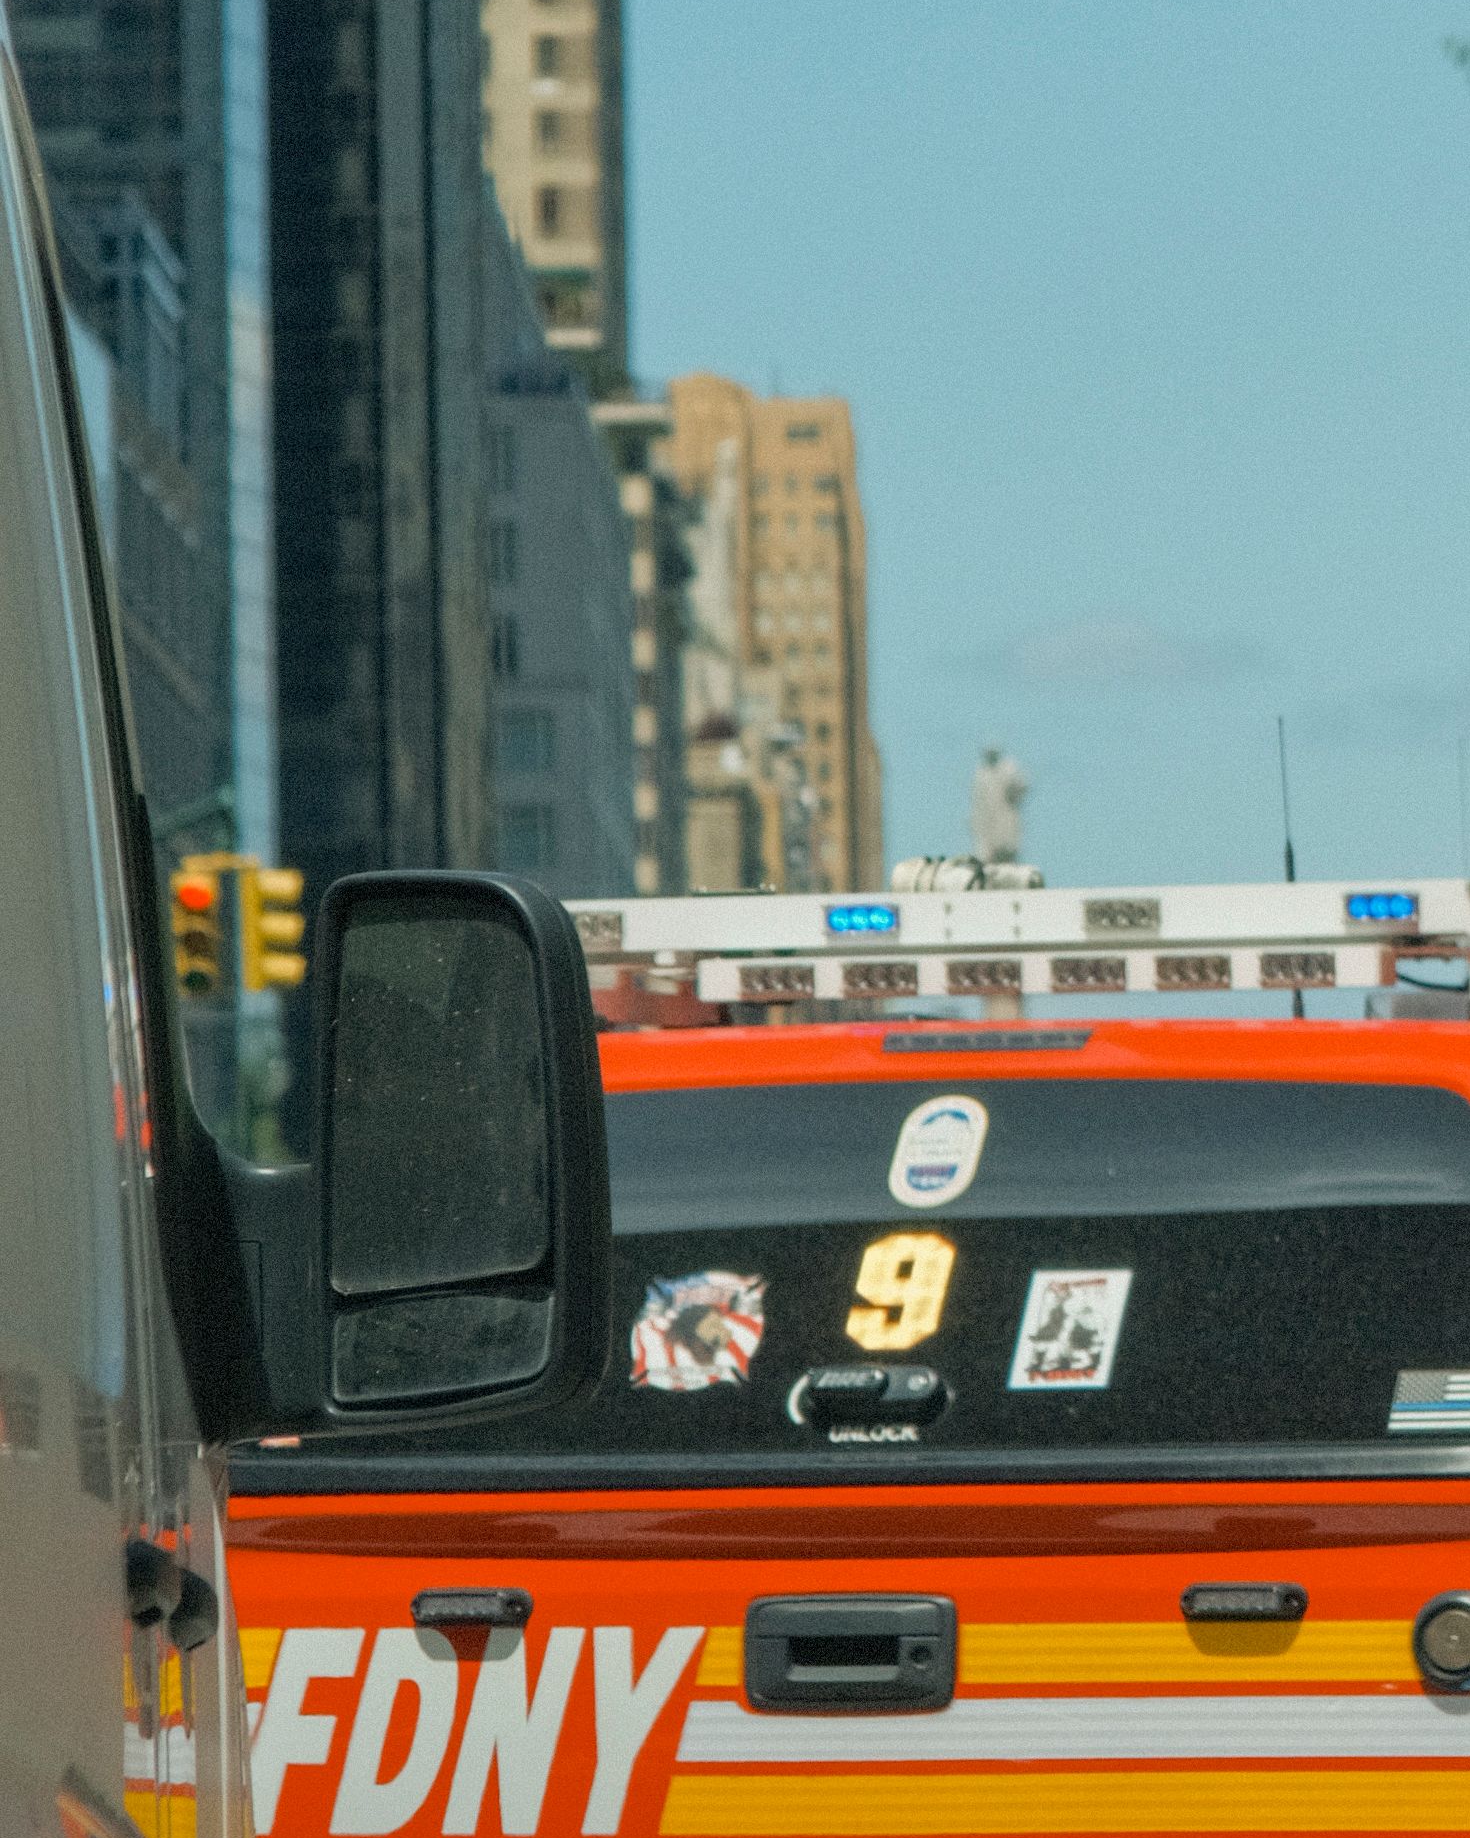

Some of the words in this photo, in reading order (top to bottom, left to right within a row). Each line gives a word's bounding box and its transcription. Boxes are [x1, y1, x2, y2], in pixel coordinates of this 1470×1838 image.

[846, 1232, 957, 1350] 9
[829, 1424, 919, 1443] UNLOCK
[253, 1627, 705, 1836] FDNY
